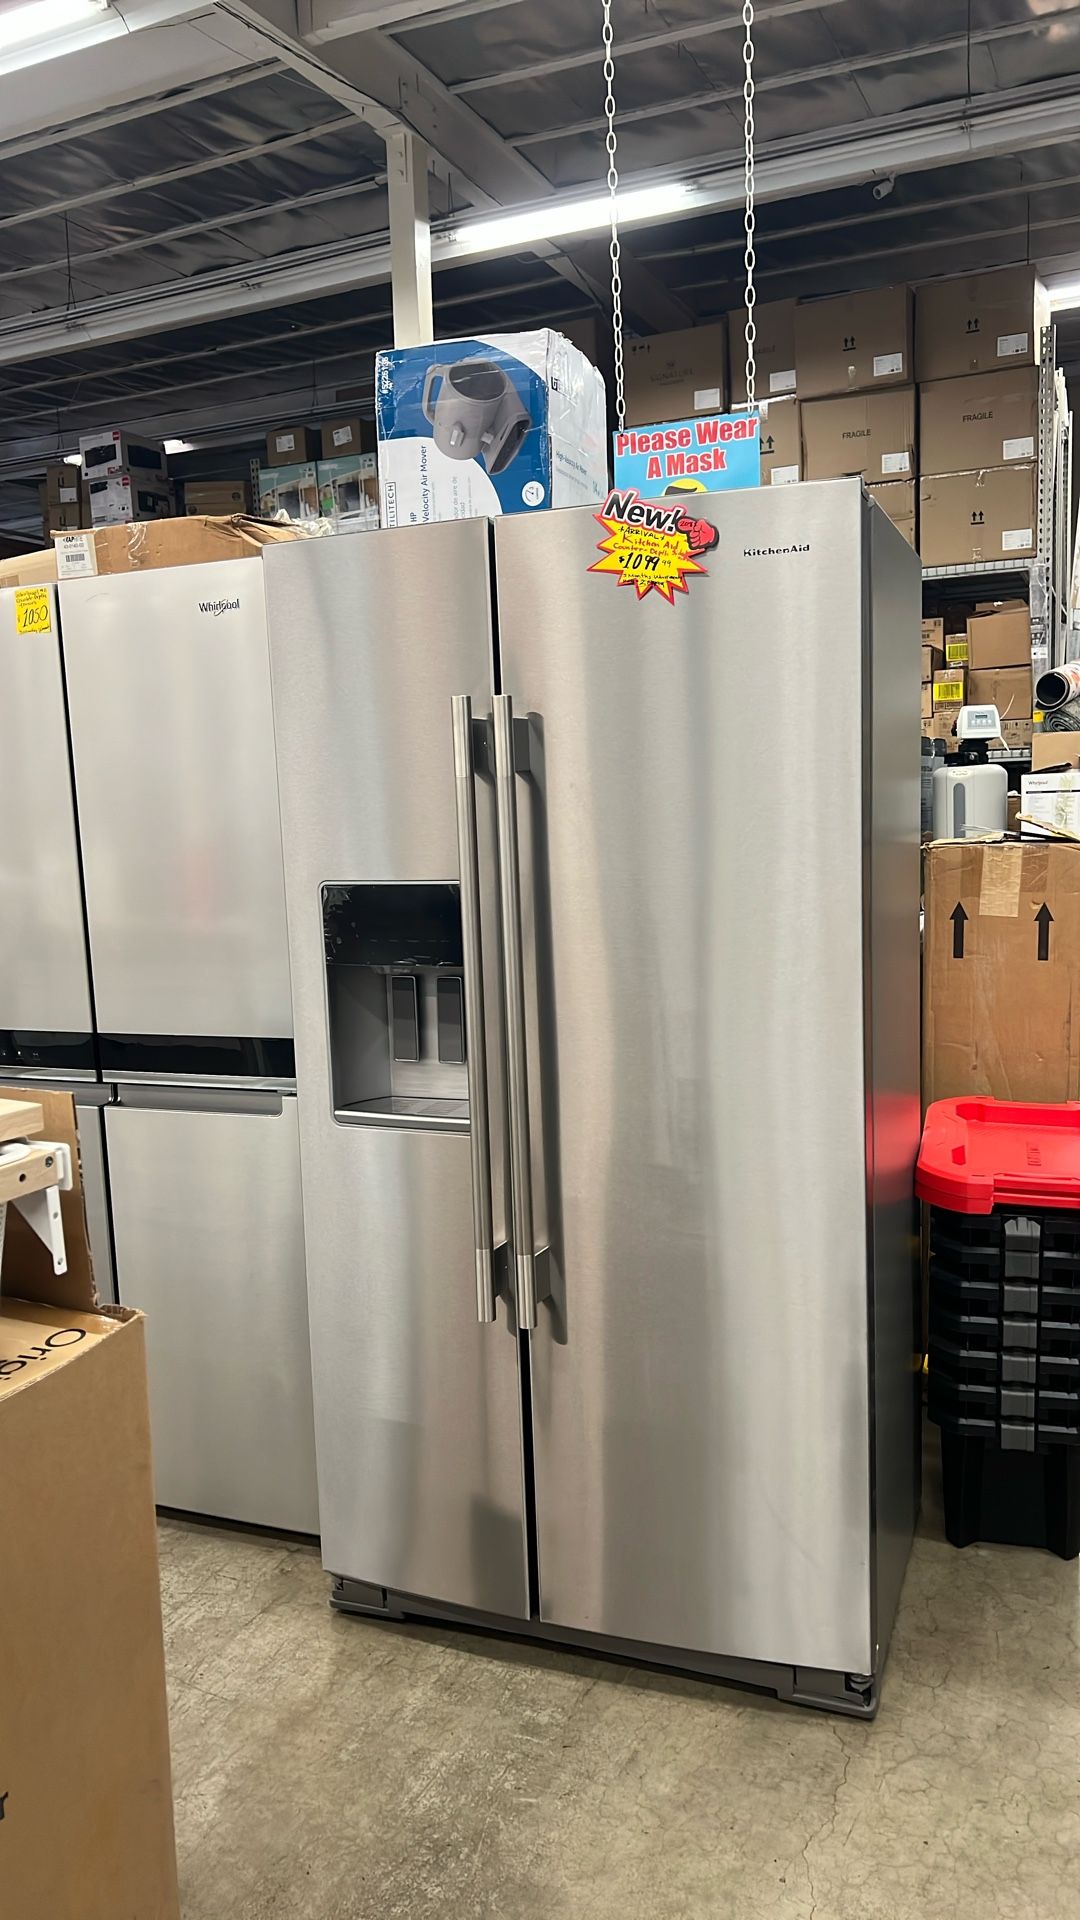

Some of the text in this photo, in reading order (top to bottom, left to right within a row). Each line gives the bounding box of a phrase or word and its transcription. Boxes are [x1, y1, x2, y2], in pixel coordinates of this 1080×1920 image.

[962, 412, 993, 422] FRAGILE
[617, 419, 758, 455] Please Wear
[842, 429, 872, 439] FRAGILE
[647, 448, 726, 479] A Mask
[420, 445, 430, 523] Velocity Air Mover
[388, 485, 396, 528] TILITECH
[604, 492, 682, 532] New!
[410, 511, 417, 522] HP
[622, 533, 679, 550] Kitchen Aid
[743, 544, 810, 557] KitchenAid
[618, 552, 660, 571] $1099
[198, 598, 240, 614] Whirlpool
[23, 605, 48, 627] 1050
